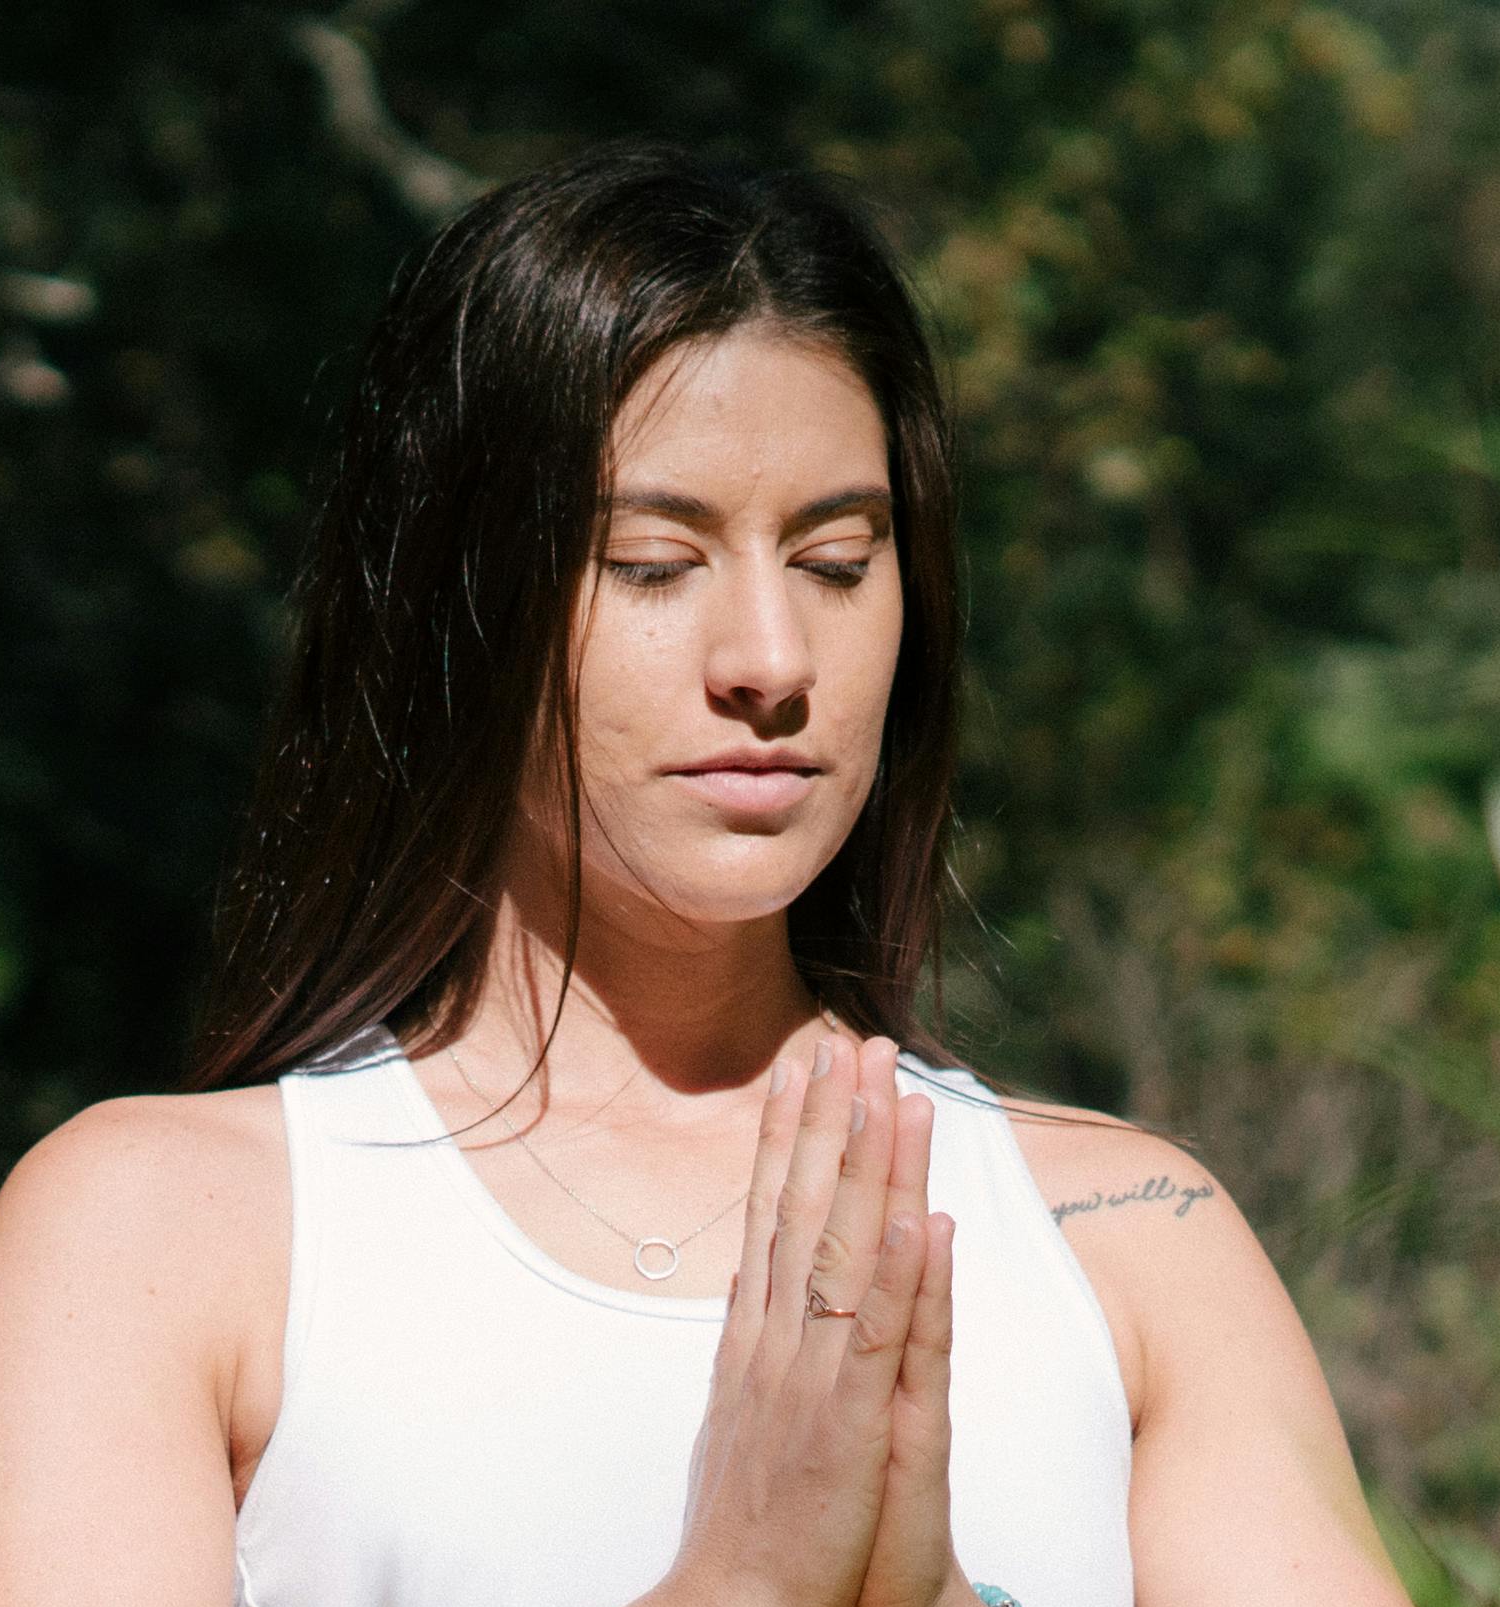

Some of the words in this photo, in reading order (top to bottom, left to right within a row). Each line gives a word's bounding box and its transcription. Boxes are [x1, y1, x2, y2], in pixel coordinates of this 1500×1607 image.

[1050, 1193, 1102, 1227] you
[1106, 1176, 1176, 1208] will
[1175, 1179, 1214, 1217] go
